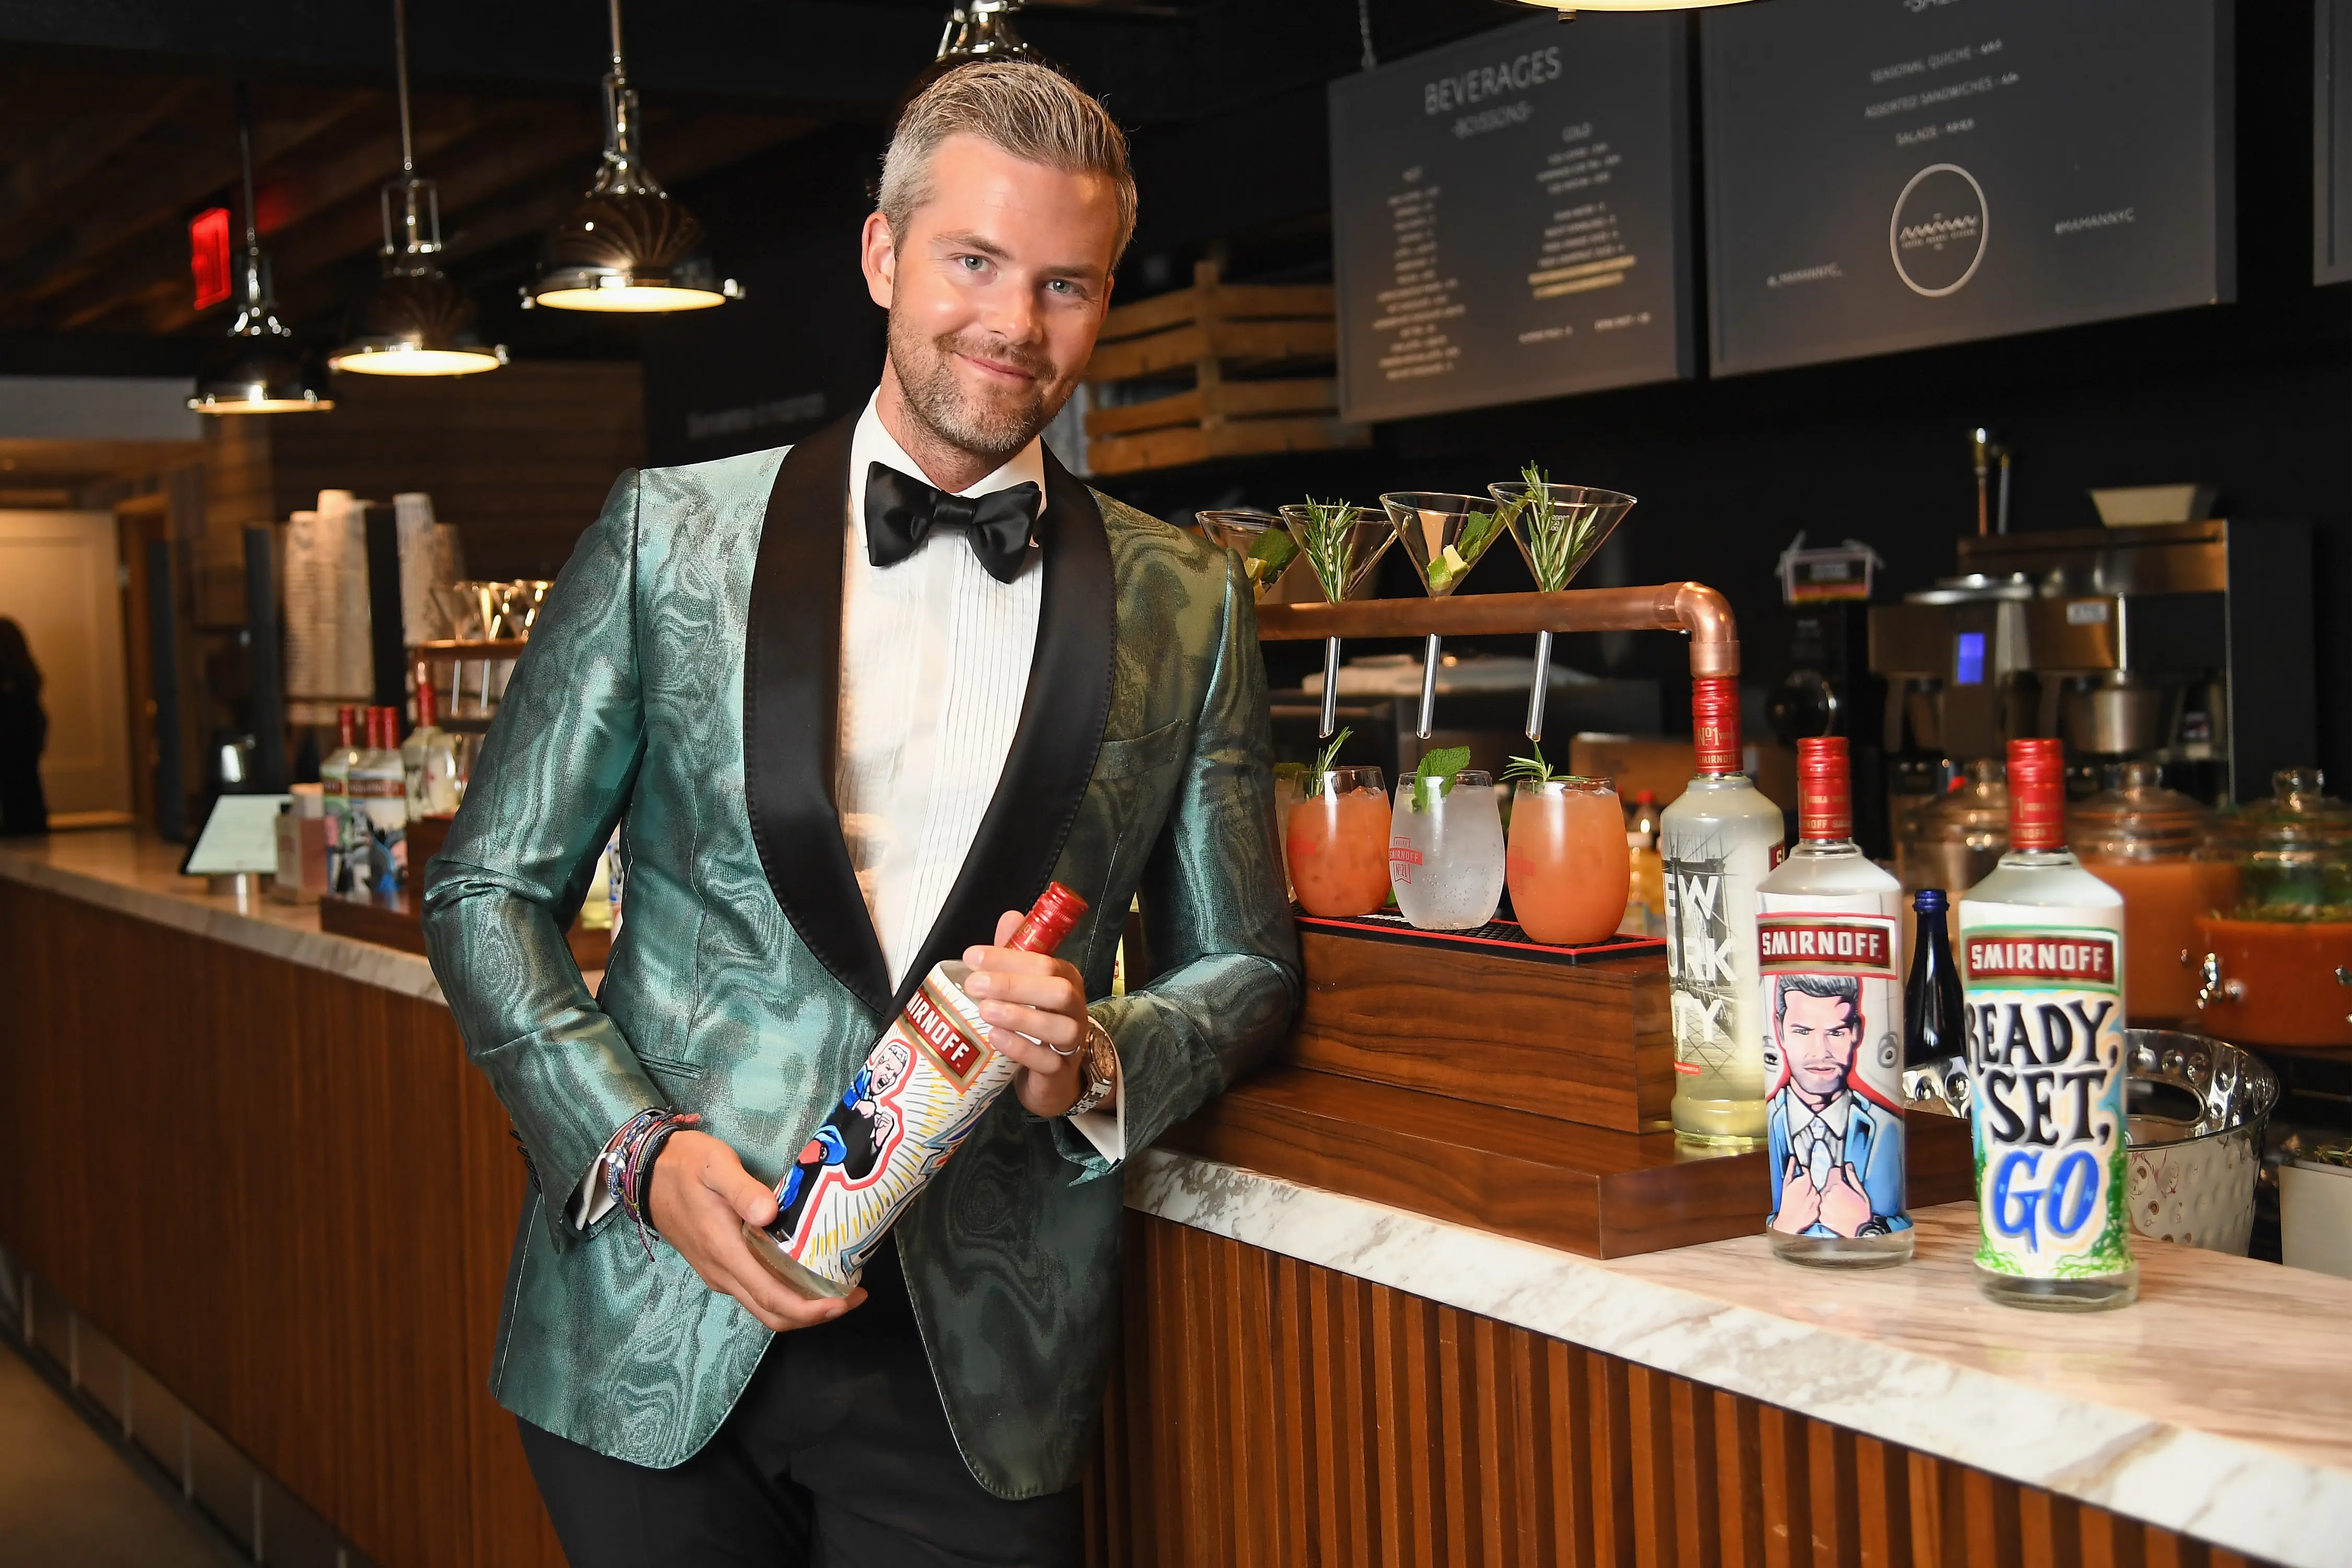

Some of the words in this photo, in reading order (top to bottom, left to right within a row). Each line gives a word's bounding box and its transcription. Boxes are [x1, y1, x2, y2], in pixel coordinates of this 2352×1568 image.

[1425, 46, 1562, 115] BEVERAGES
[1664, 872, 1719, 920] EW
[1667, 936, 1738, 982] ORK
[1761, 930, 1880, 957] SMIRNOFF
[1971, 943, 2105, 972] SMIRNOFF
[906, 990, 970, 1062] MIRNOFF
[1993, 1150, 2100, 1253] GO
